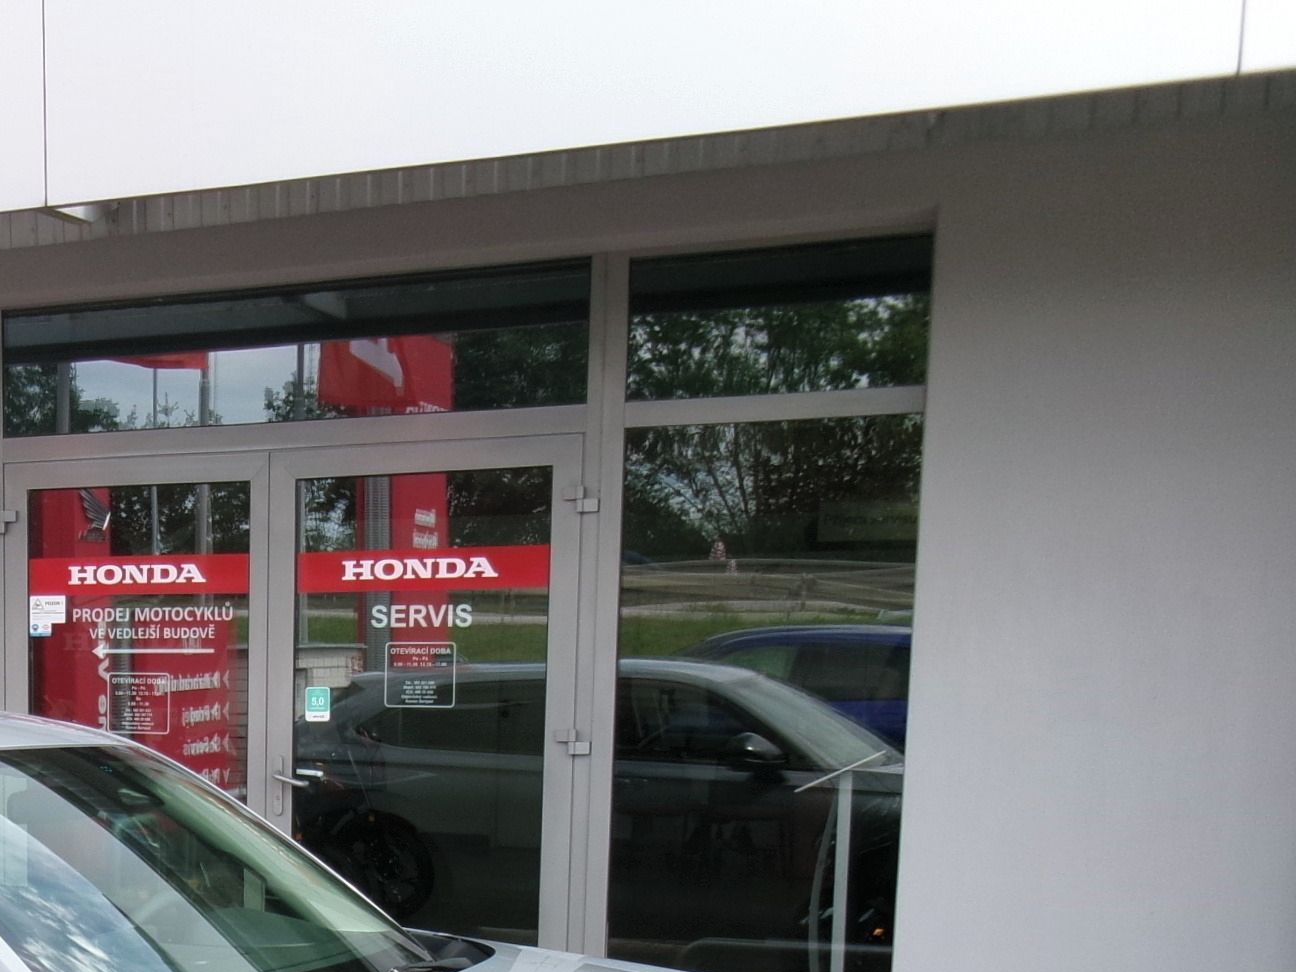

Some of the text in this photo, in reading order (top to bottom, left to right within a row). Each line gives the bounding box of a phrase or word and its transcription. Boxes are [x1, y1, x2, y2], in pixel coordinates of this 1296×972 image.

[68, 563, 207, 586] HONDA
[341, 557, 499, 581] HONDA
[72, 601, 234, 622] PRODEJ MOTOCYKLŮ
[370, 603, 473, 628] SERVIS
[89, 624, 216, 639] VE VEDLEJŠÍ BUDOVĚ
[430, 647, 452, 655] DOBA
